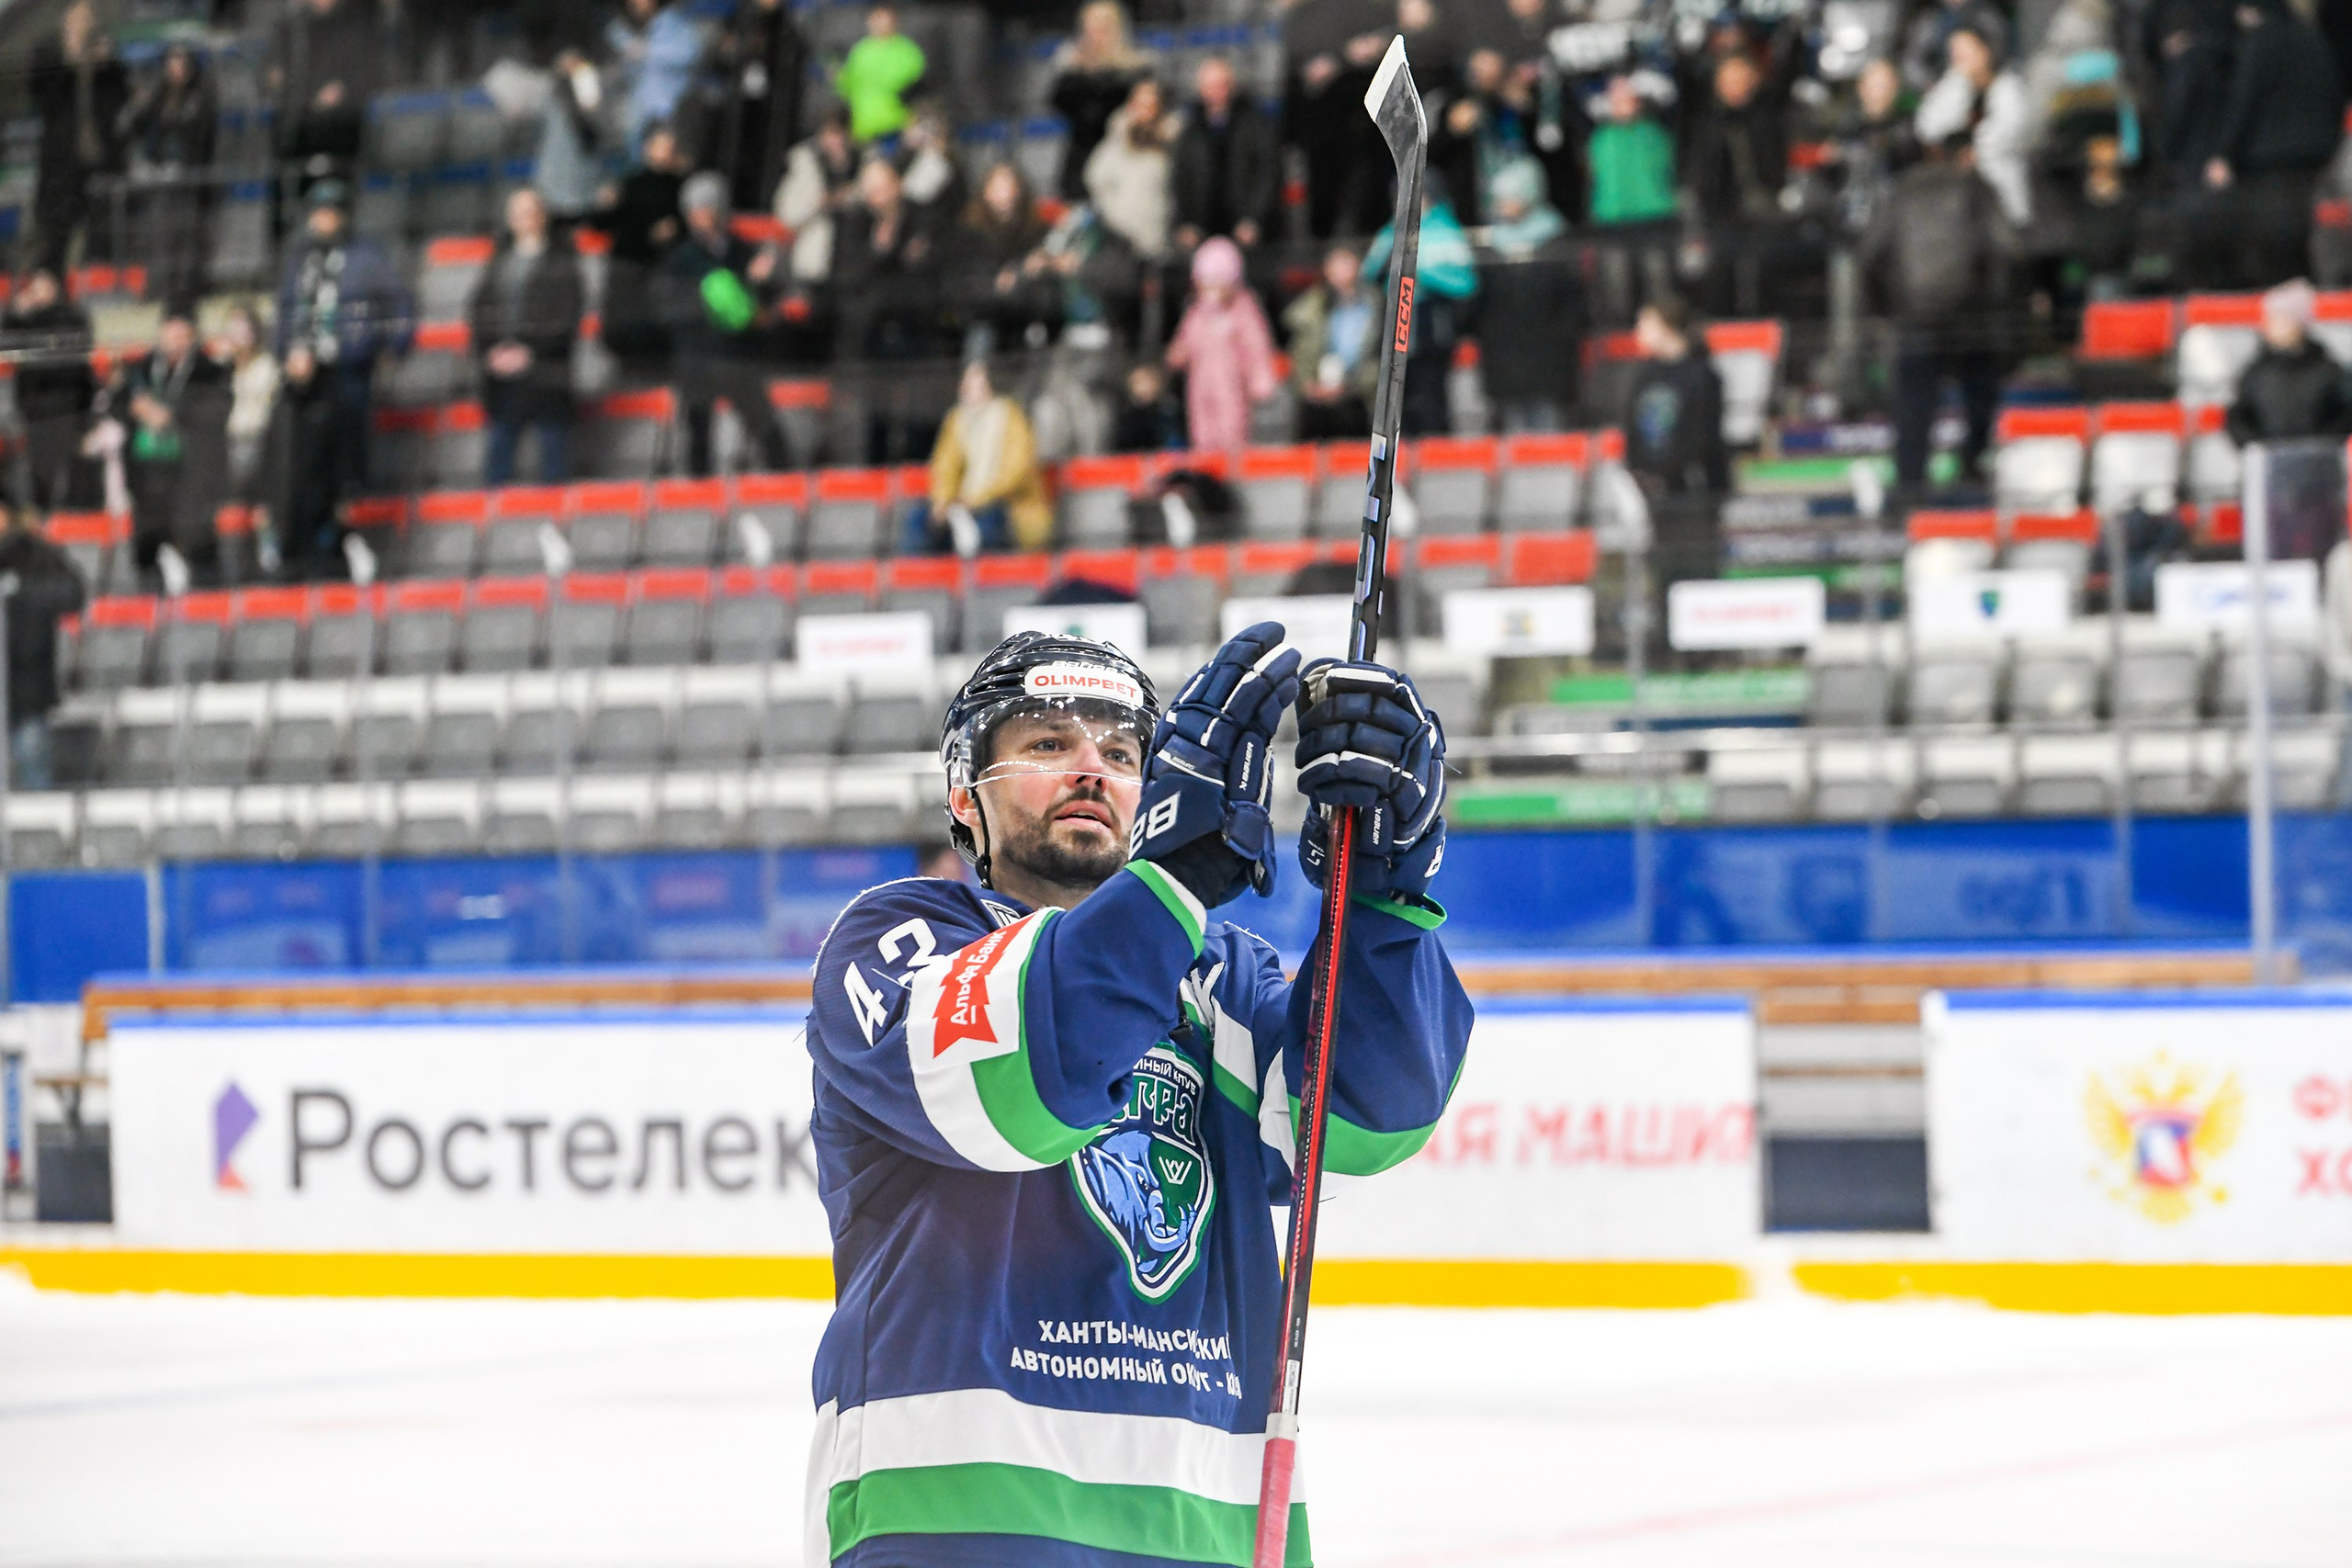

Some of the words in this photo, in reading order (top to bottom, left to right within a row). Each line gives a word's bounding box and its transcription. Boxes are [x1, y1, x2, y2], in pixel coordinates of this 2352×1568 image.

[1397, 283, 1412, 345] CCM
[1034, 675, 1137, 699] OLIMPBET
[288, 1087, 818, 1193] Ростелек
[1010, 1347, 1168, 1385] АВТОНОМНЫЙ
